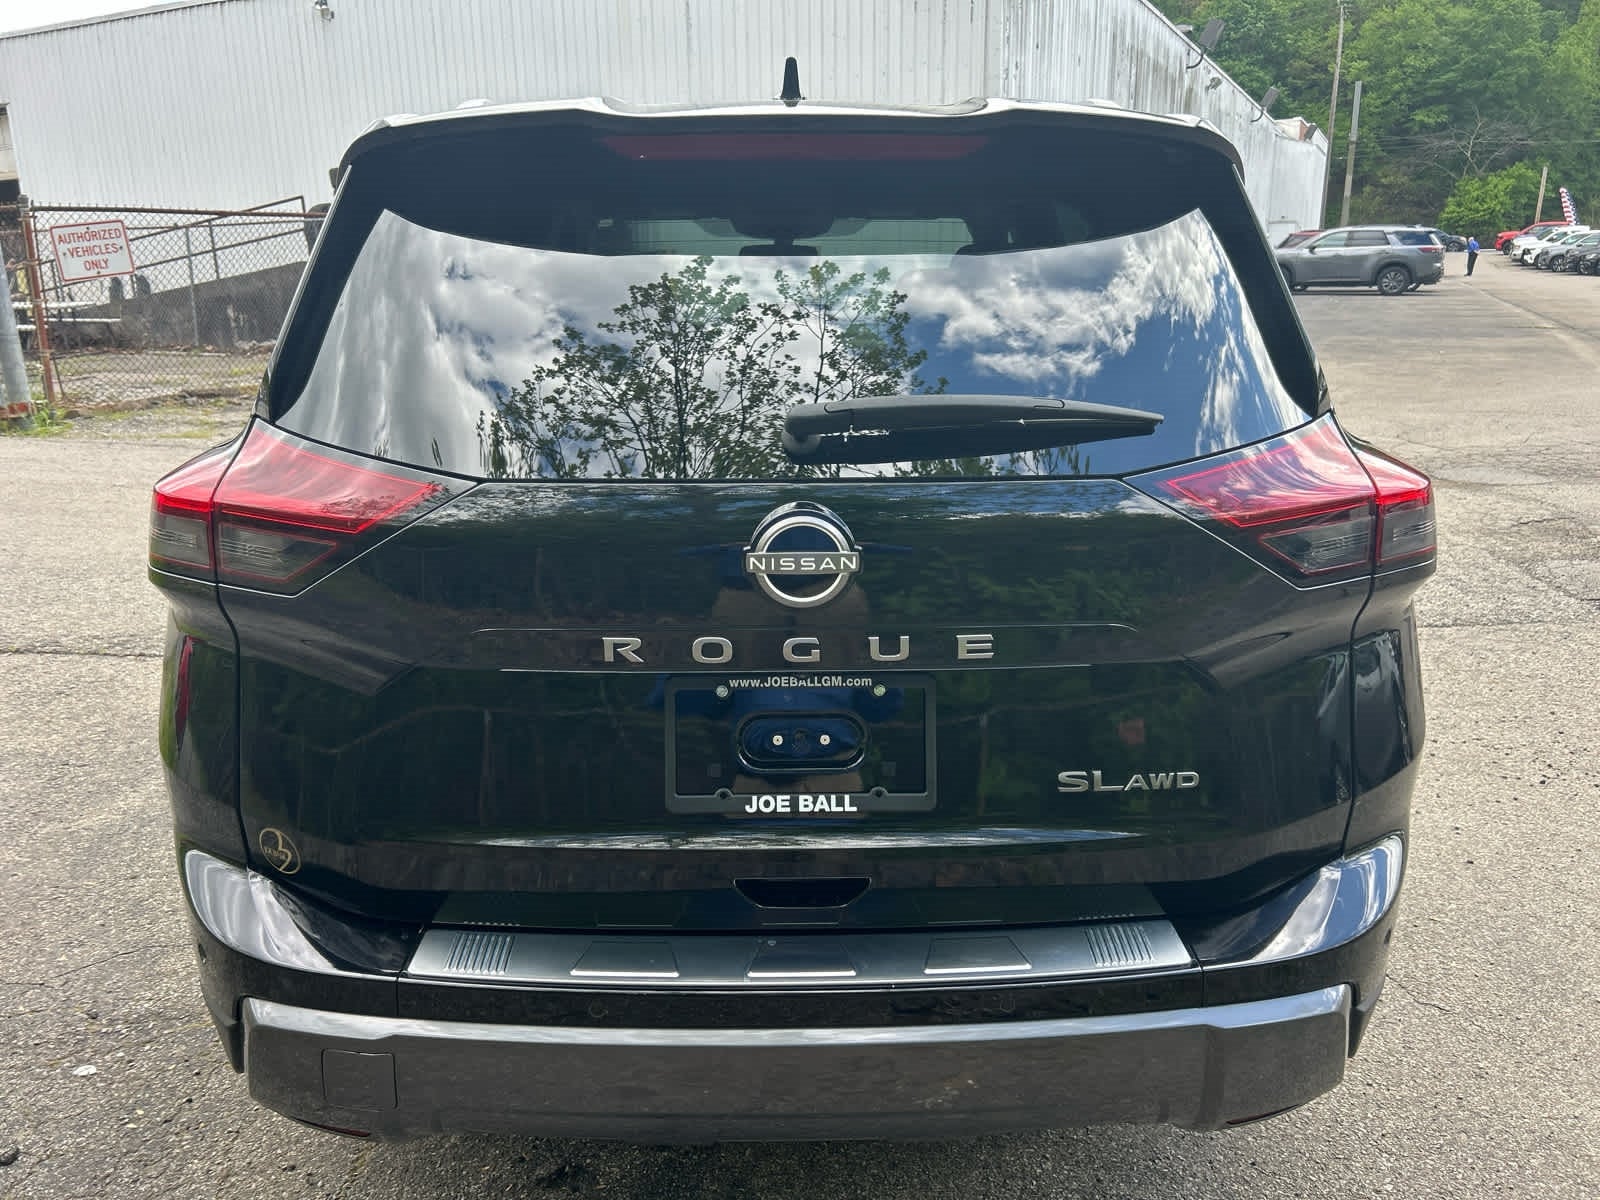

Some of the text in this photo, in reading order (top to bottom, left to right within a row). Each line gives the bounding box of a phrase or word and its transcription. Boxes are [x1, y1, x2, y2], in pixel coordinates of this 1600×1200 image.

[57, 228, 122, 245] AUTHORIZED
[67, 243, 119, 258] VEHICLES
[83, 258, 109, 271] ONLY
[749, 556, 857, 571] NISSAN
[602, 633, 995, 664] ROGUE
[729, 676, 872, 688] www.JOEBALLGM.com
[744, 794, 858, 813] JOE BALL
